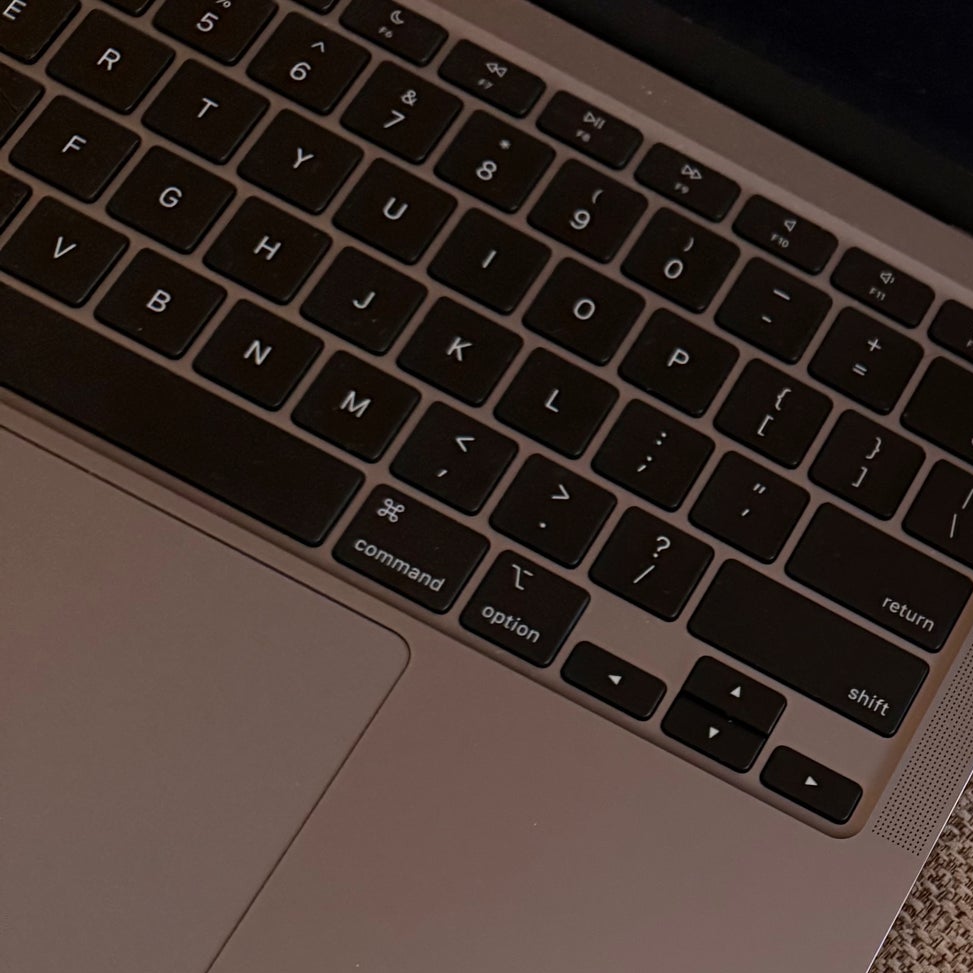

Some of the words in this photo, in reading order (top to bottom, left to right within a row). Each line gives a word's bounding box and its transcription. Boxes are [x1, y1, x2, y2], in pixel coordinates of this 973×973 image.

[96, 47, 121, 71] R
[289, 61, 312, 81] 6
[293, 147, 314, 169] Y
[476, 160, 497, 181] 8
[158, 186, 183, 208] G
[383, 197, 408, 220] U
[253, 235, 282, 261] H
[770, 233, 790, 249] F10
[146, 289, 171, 313] B
[869, 287, 886, 302] F11
[243, 339, 272, 366] N
[446, 336, 473, 362] K
[354, 537, 446, 593] command
[480, 602, 541, 645] option
[880, 593, 936, 634] return
[846, 684, 890, 718] shift
